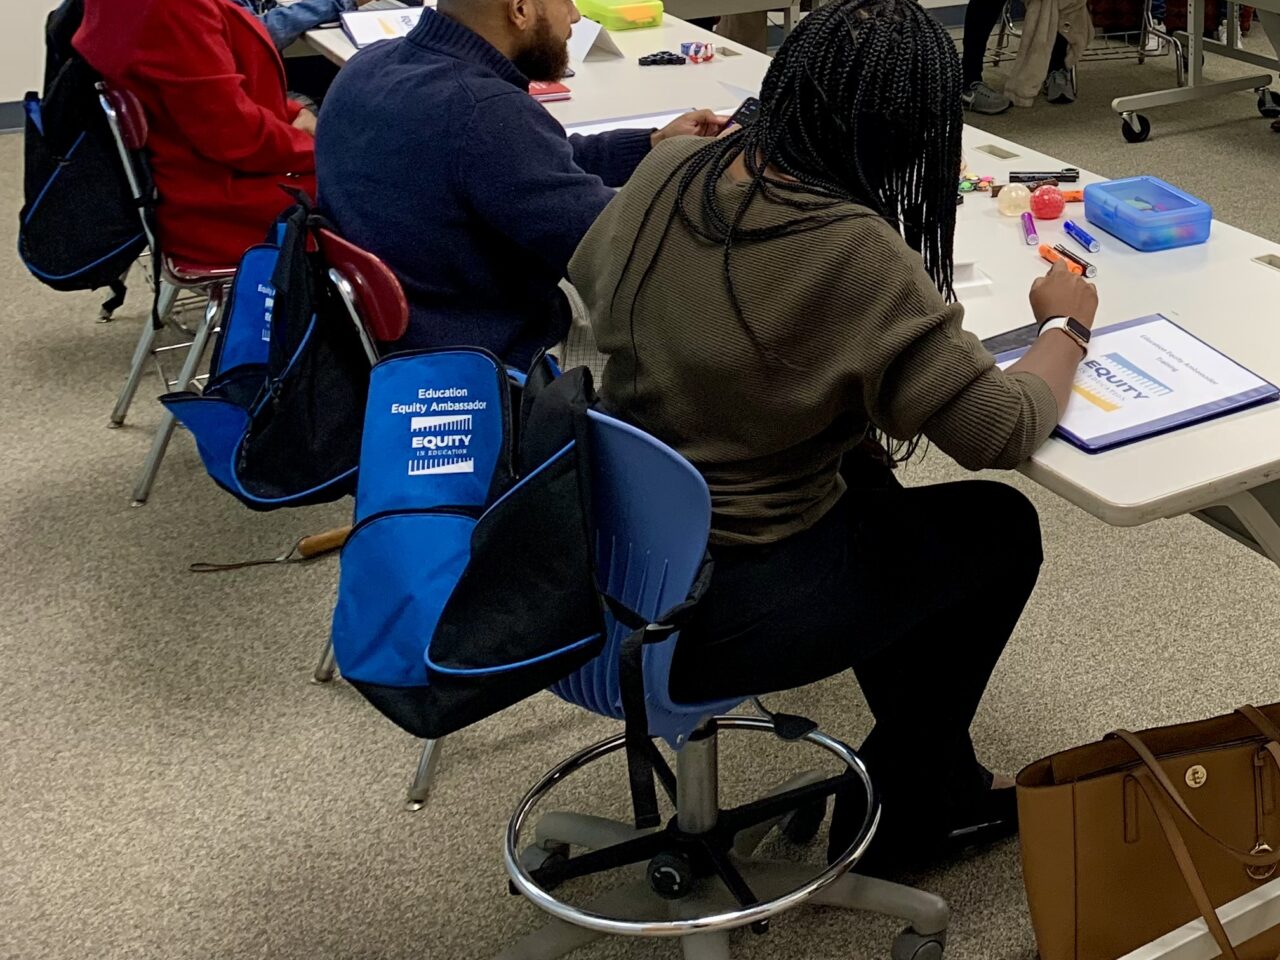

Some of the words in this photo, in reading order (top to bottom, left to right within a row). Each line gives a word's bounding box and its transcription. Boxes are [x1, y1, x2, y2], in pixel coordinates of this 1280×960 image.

[1084, 359, 1151, 400] EQUITY
[418, 388, 468, 399] Education
[392, 402, 427, 414] Equity
[430, 400, 487, 412] Ambassador
[412, 434, 472, 450] EQUITY
[428, 448, 467, 456] EDUCATION
